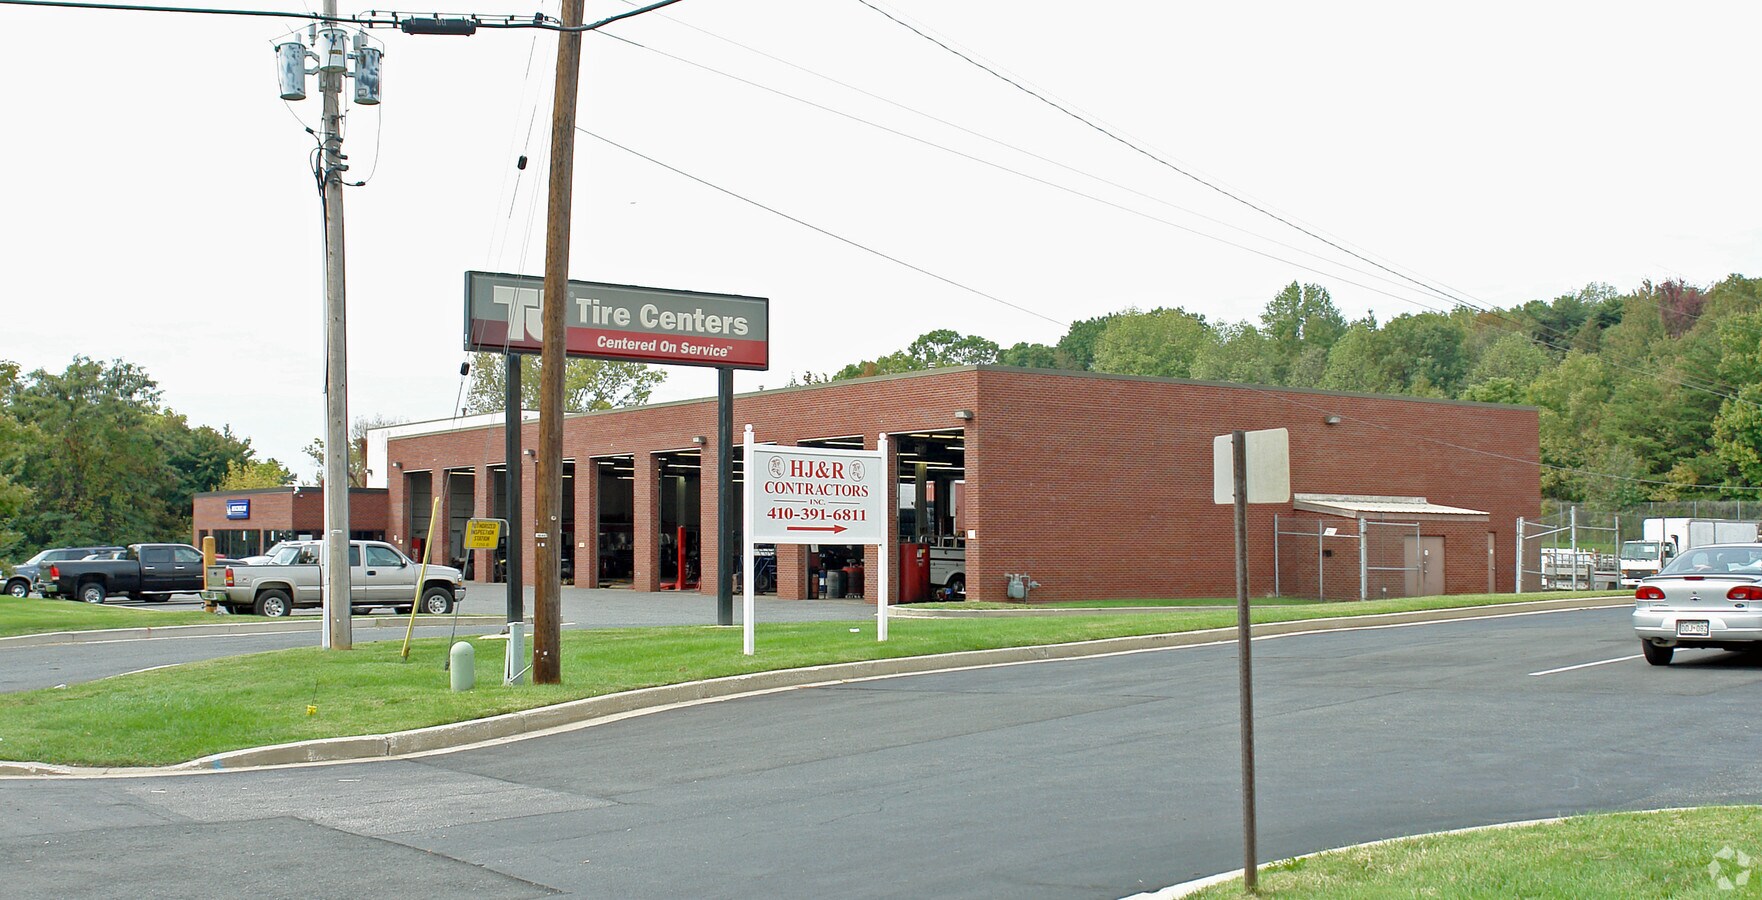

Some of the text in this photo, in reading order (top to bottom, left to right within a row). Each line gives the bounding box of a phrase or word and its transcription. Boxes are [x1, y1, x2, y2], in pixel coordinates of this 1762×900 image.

[493, 285, 545, 342] T
[575, 297, 750, 336] Tire Centers
[596, 335, 657, 352] Centered
[659, 340, 677, 353] On
[790, 459, 845, 479] HJ&R
[764, 480, 869, 497] CONTRACTORS
[809, 498, 826, 506] INC.
[766, 506, 867, 522] 410-391-6811
